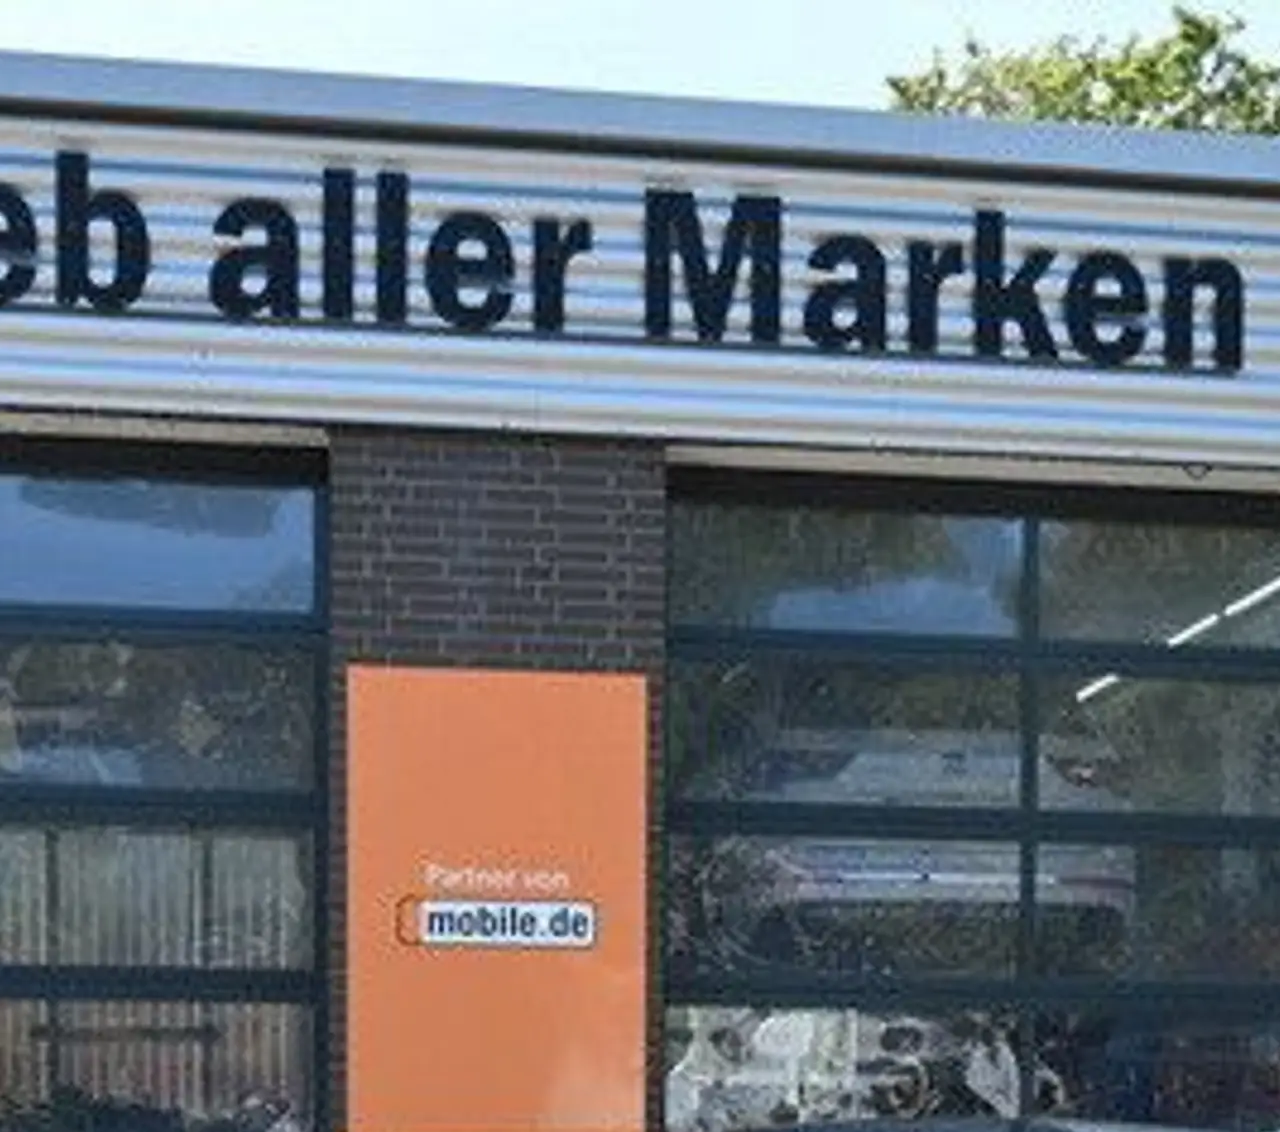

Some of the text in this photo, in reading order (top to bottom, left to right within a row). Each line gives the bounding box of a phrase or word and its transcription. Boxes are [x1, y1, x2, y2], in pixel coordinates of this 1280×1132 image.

[208, 164, 592, 334] aller
[642, 184, 1246, 376] Marken
[423, 863, 571, 891] Partner von
[427, 904, 589, 938] mobile.de
